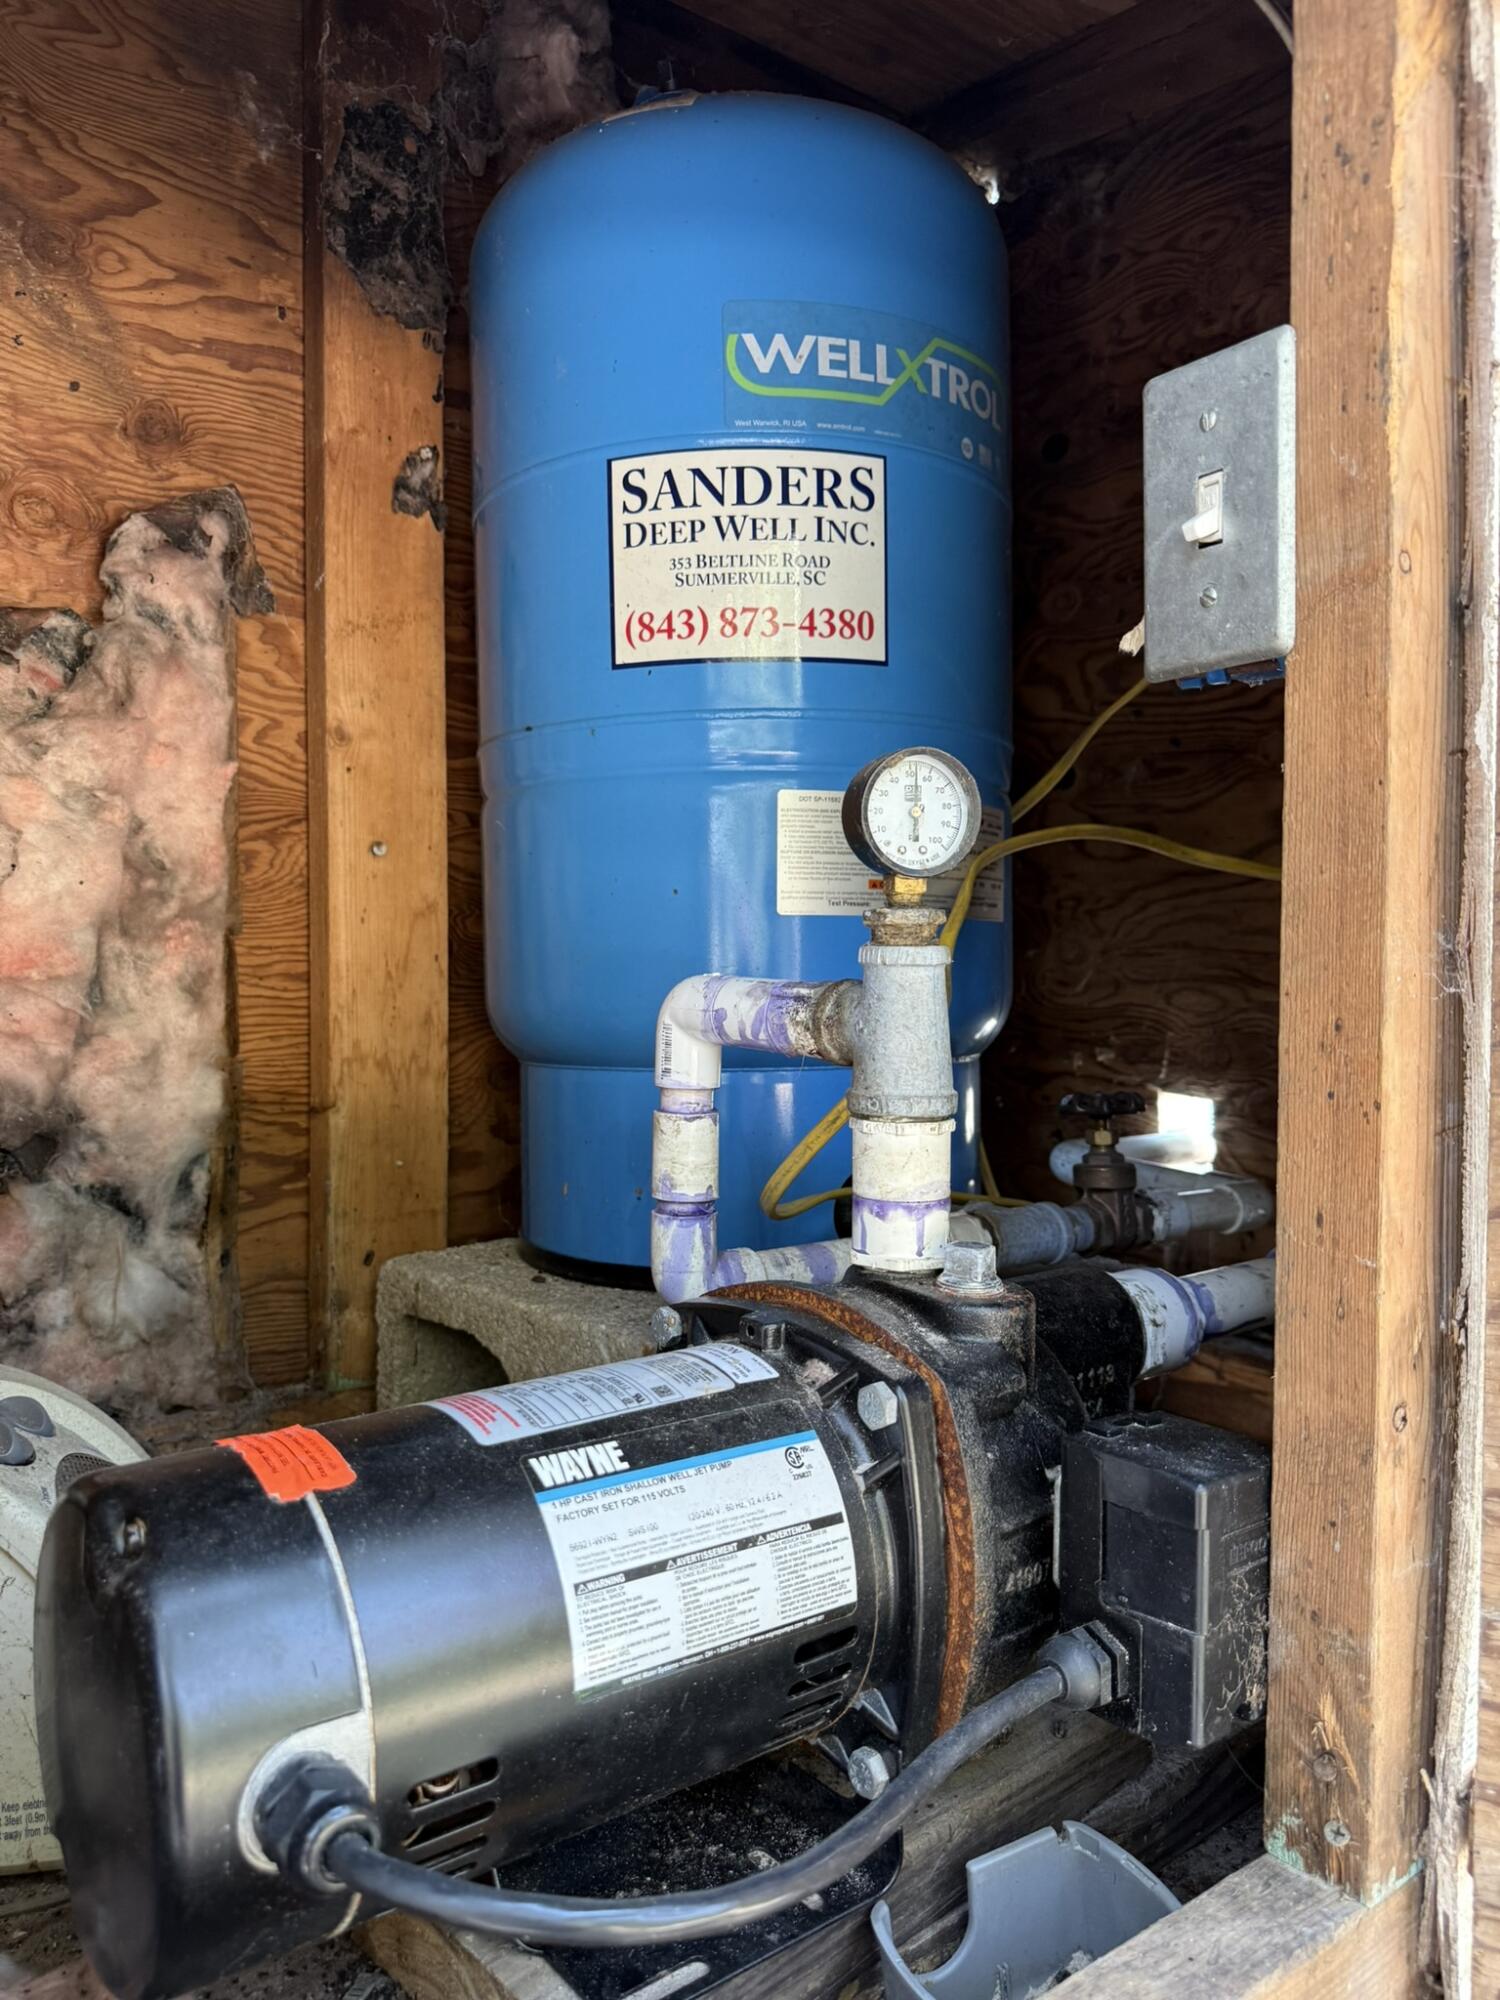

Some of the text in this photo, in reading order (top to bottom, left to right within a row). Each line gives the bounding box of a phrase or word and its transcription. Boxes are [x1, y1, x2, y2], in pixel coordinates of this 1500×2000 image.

[621, 465, 876, 515] SANDERS
[623, 514, 876, 549] DEEP WELL INC.
[669, 552, 831, 571] 353 BELTLINE ROAD
[674, 570, 827, 588] SUMMERVILLE, SC
[625, 605, 875, 650] (843) 873-4380
[905, 770, 915, 778] 50
[922, 775, 933, 783] 60
[879, 786, 945, 797] 30 70
[873, 802, 952, 815] 20 80
[877, 820, 952, 833] 10 90
[928, 836, 943, 845] 100
[529, 1440, 630, 1488] WAYNE
[559, 1498, 572, 1508] HP
[574, 1492, 598, 1504] CAST
[600, 1486, 623, 1498] IRON
[624, 1476, 668, 1493] SHALLOW
[668, 1471, 693, 1483] WELL
[694, 1466, 710, 1477] JET
[710, 1460, 733, 1472] PUMP
[556, 1485, 687, 1523] FACTORY SET FOR 115 VOLTS
[765, 1522, 812, 1542] ADVERTENCIA
[675, 1541, 738, 1566] AVERTISSEMENT
[586, 1572, 626, 1592] WARNING
[2, 1801, 20, 1814] Keep
